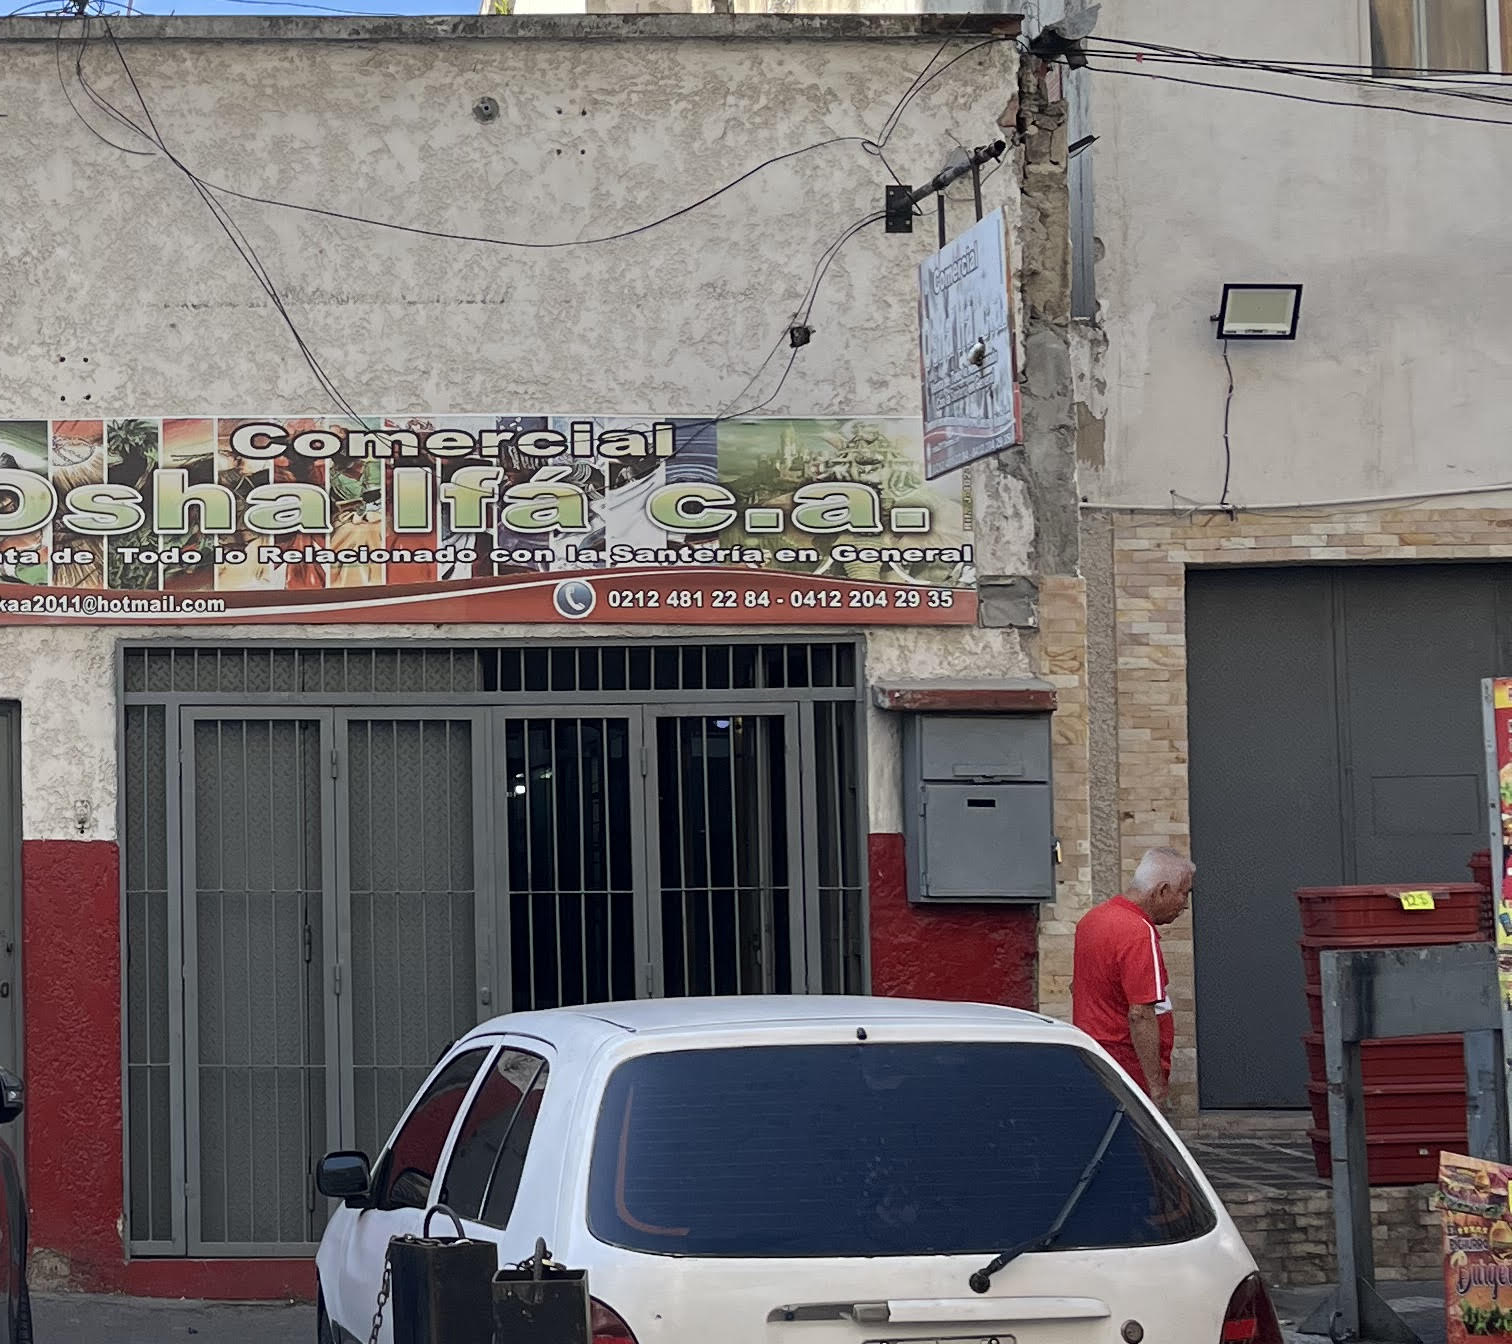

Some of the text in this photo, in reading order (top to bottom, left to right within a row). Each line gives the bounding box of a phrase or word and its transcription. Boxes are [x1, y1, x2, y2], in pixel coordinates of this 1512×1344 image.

[933, 240, 978, 295] Comercial
[230, 422, 675, 458] Comercial
[392, 464, 589, 533] Ifá
[648, 481, 931, 533] c.a.
[51, 547, 94, 565] de
[118, 547, 202, 565] Todo
[215, 547, 246, 564] lo
[258, 546, 478, 564] Relacionado
[489, 547, 557, 564] con
[566, 545, 604, 563] la
[609, 544, 771, 564] Santería
[775, 547, 818, 563] en
[831, 544, 973, 563] General
[607, 589, 660, 609] 0212
[666, 589, 705, 609] 481
[710, 589, 737, 609] 22
[743, 589, 771, 609] 84
[790, 589, 842, 609] 0412
[848, 589, 888, 609] 204
[894, 589, 921, 609] 29
[926, 589, 954, 609] 35
